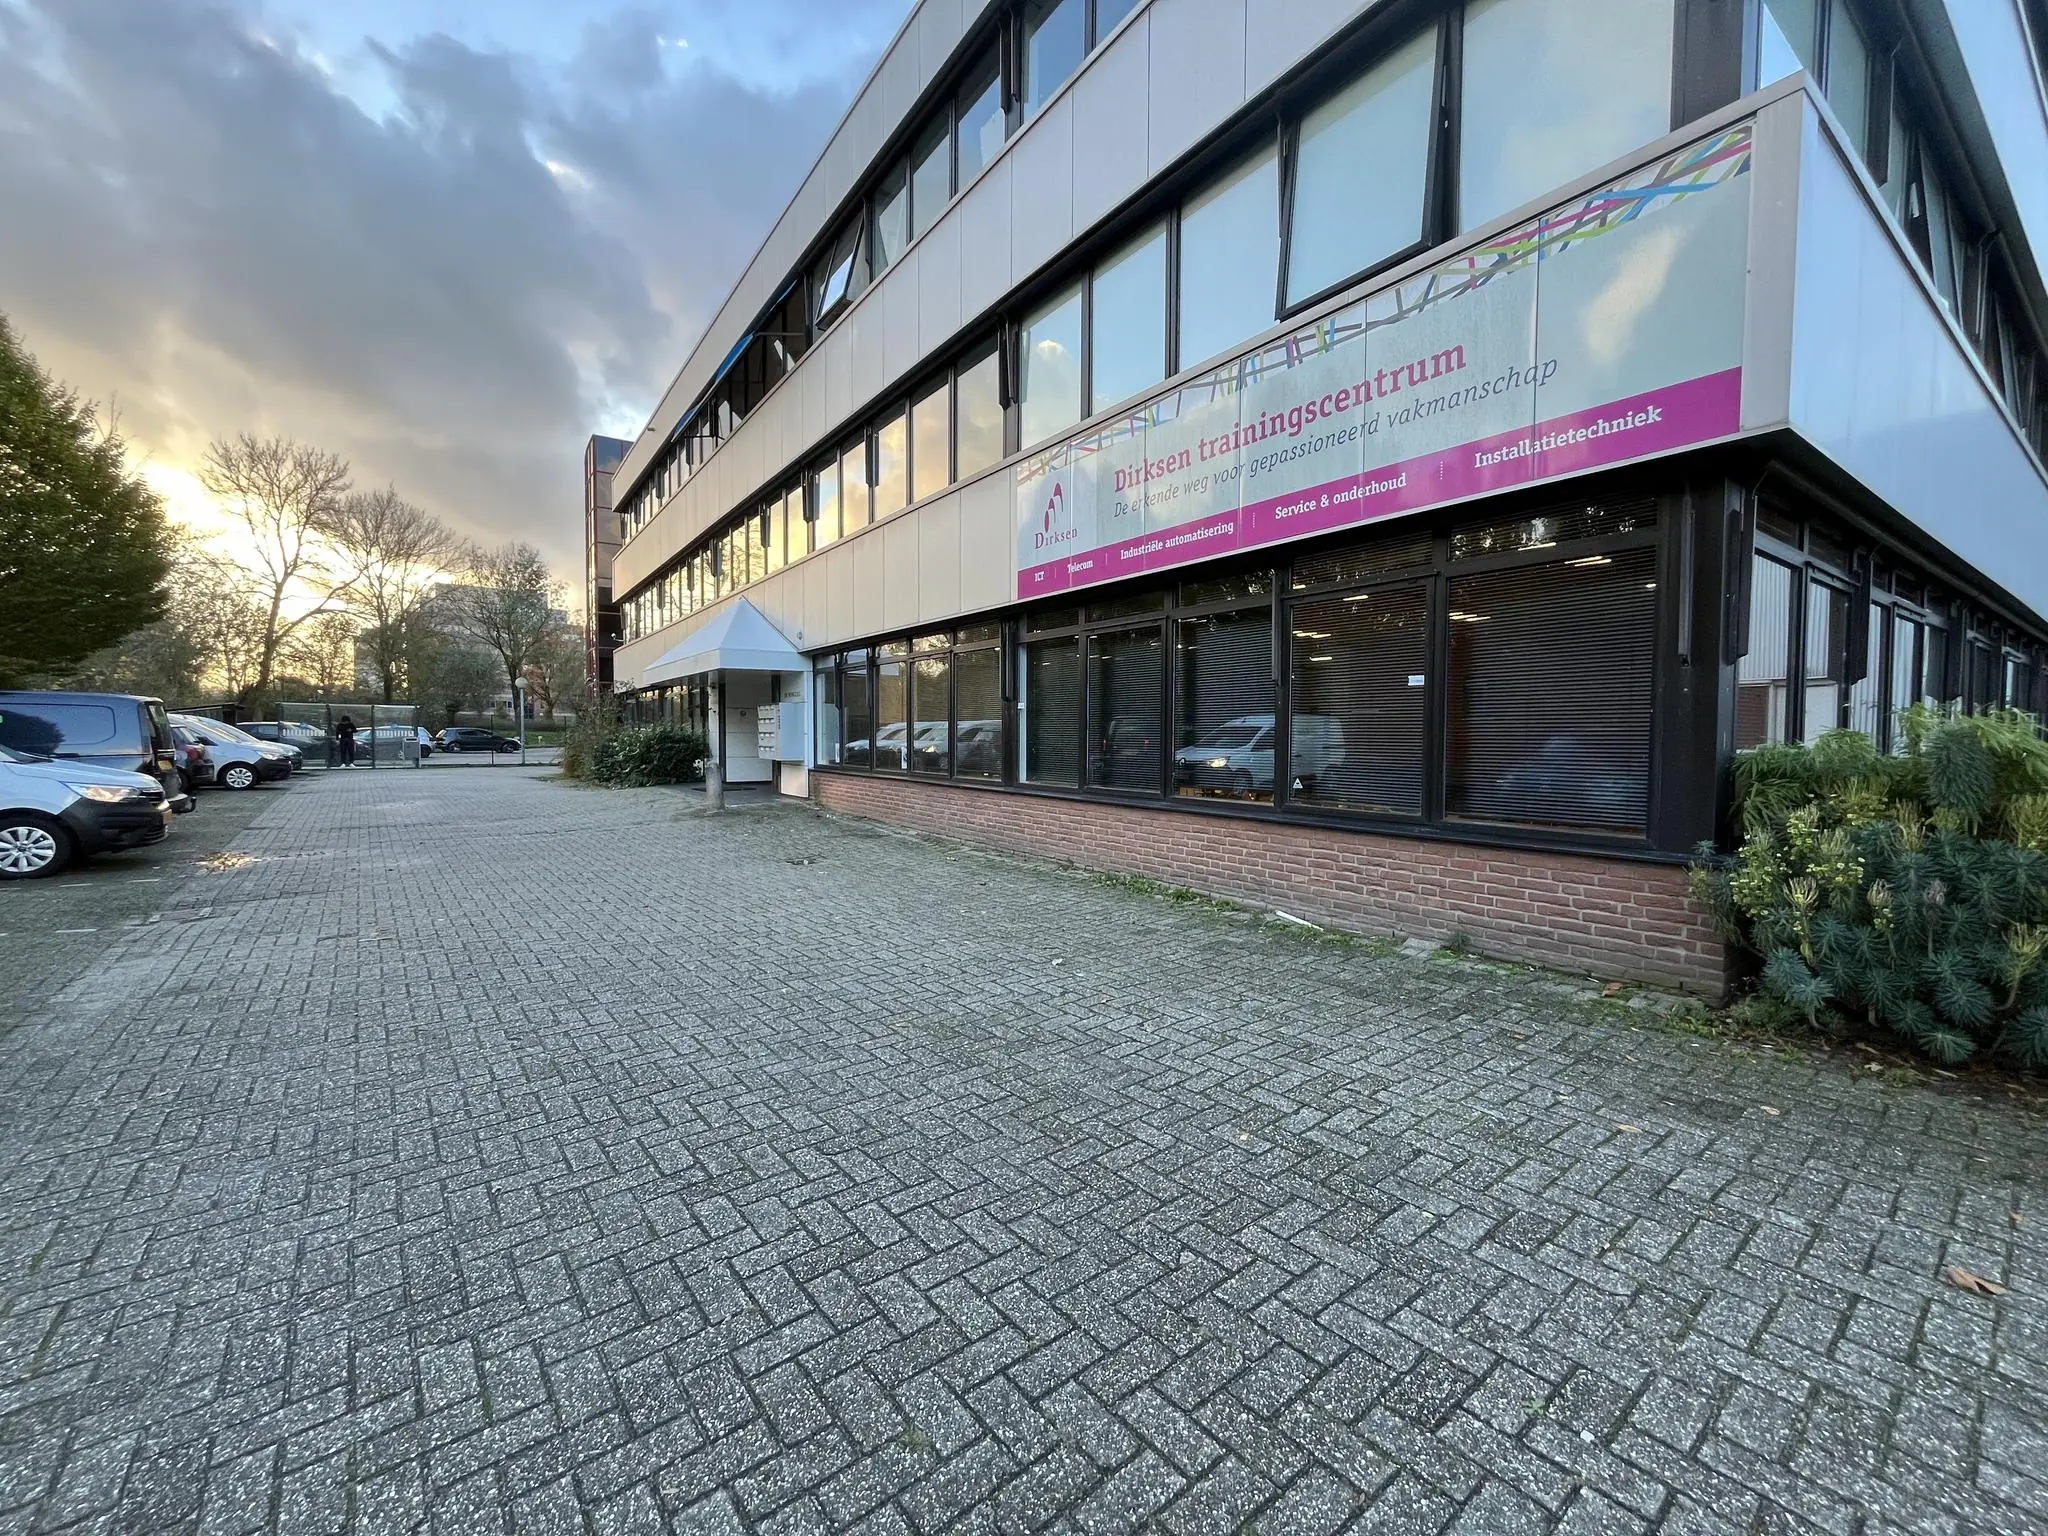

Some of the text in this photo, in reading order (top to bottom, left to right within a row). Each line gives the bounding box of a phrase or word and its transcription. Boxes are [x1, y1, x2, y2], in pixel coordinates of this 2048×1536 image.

[1114, 344, 1467, 493] Dirksen trainingscentrum
[1114, 358, 1558, 517] De erkende weg voor gepassioneerd vakmanschap
[1474, 405, 1663, 468] Installatietechniek
[1275, 472, 1407, 519] Service & onderhoud
[1034, 528, 1078, 549] Dirksen
[1120, 522, 1234, 560] Industriële automatisering
[1034, 570, 1045, 582] ICT
[1067, 560, 1094, 573] Telecom
